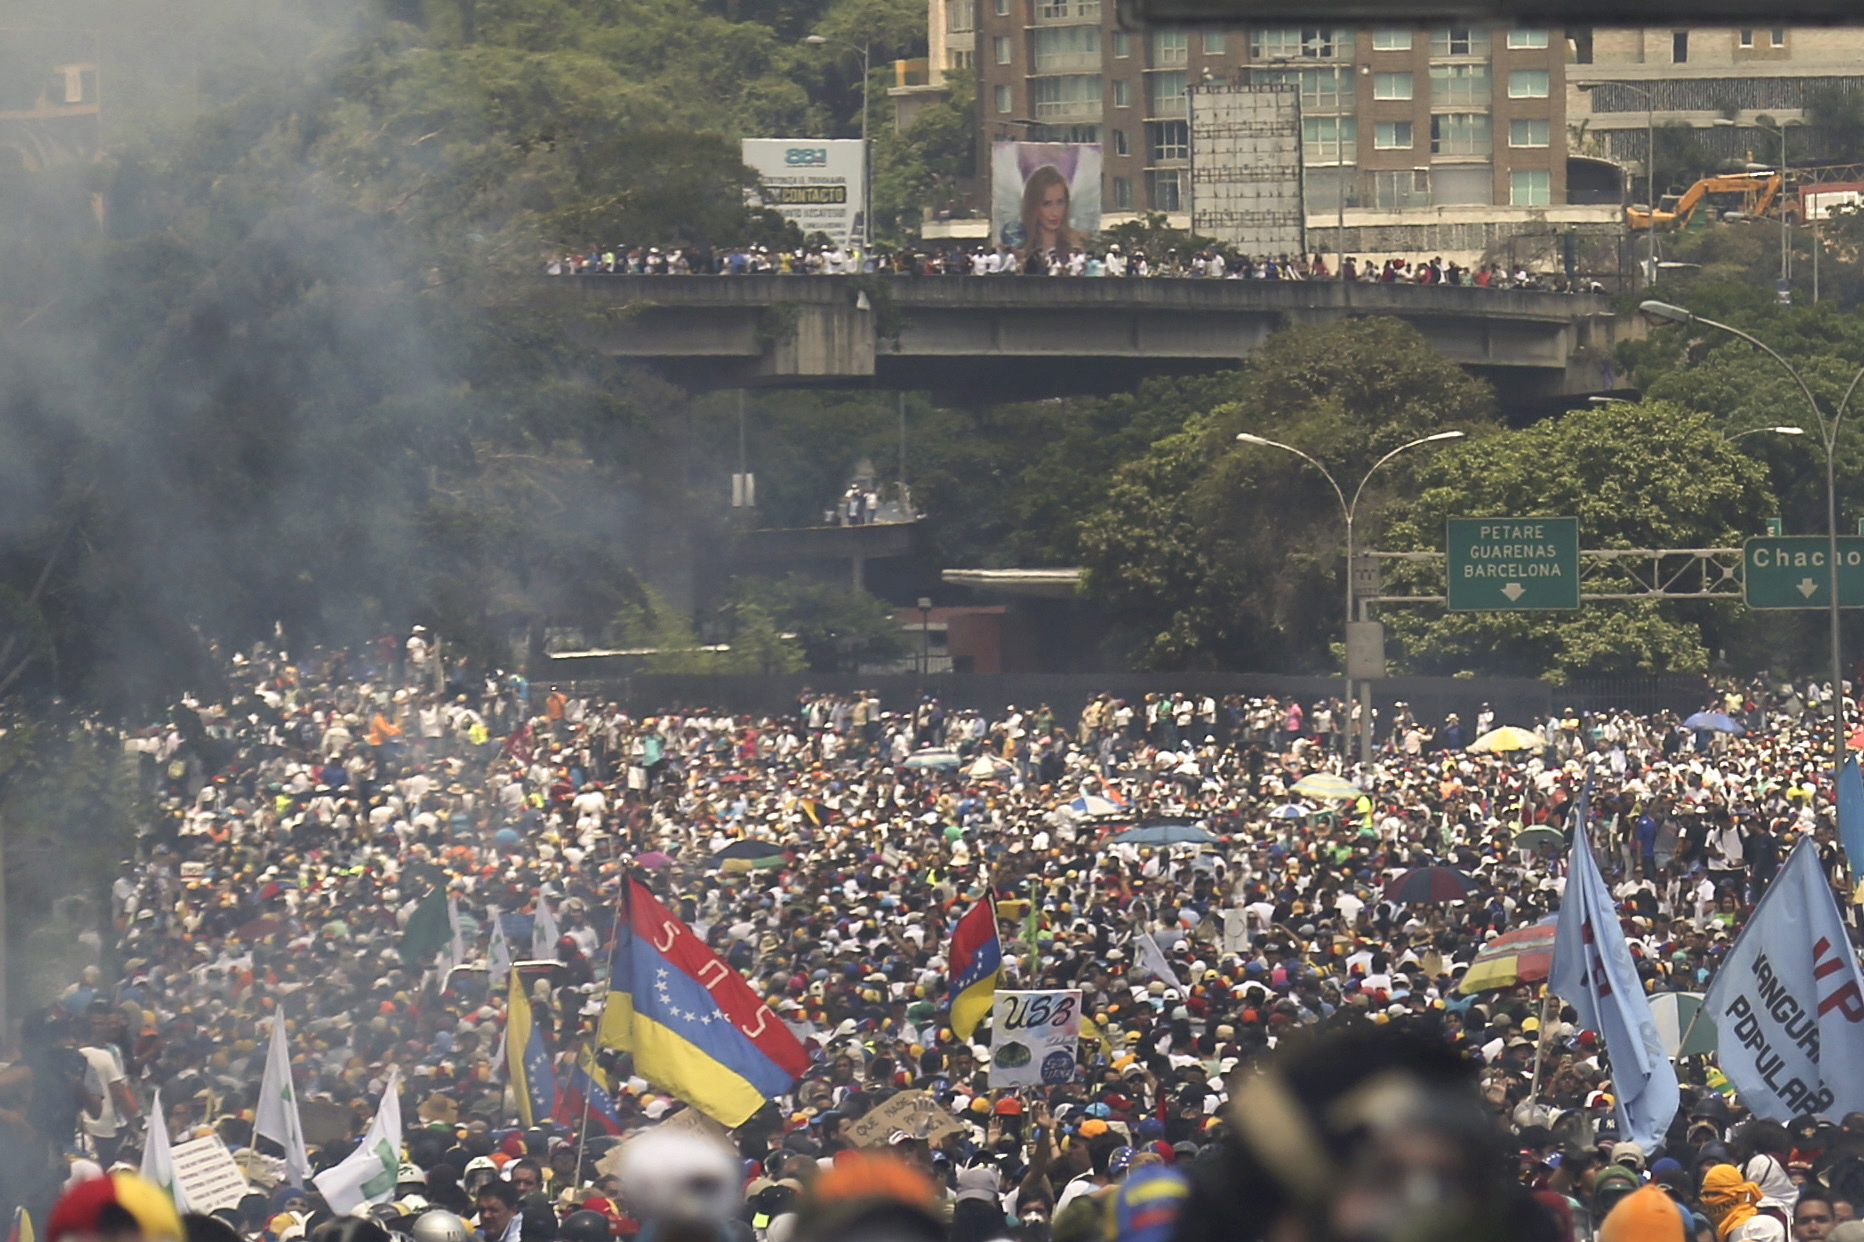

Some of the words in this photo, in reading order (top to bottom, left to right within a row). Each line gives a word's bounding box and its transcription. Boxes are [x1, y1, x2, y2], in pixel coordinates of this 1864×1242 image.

[781, 187, 844, 202] CONTACTO
[1480, 525, 1544, 540] PETARE
[1470, 544, 1556, 559] GUARENAS
[1464, 563, 1562, 578] BARCELONA
[1003, 995, 1075, 1030] USB
